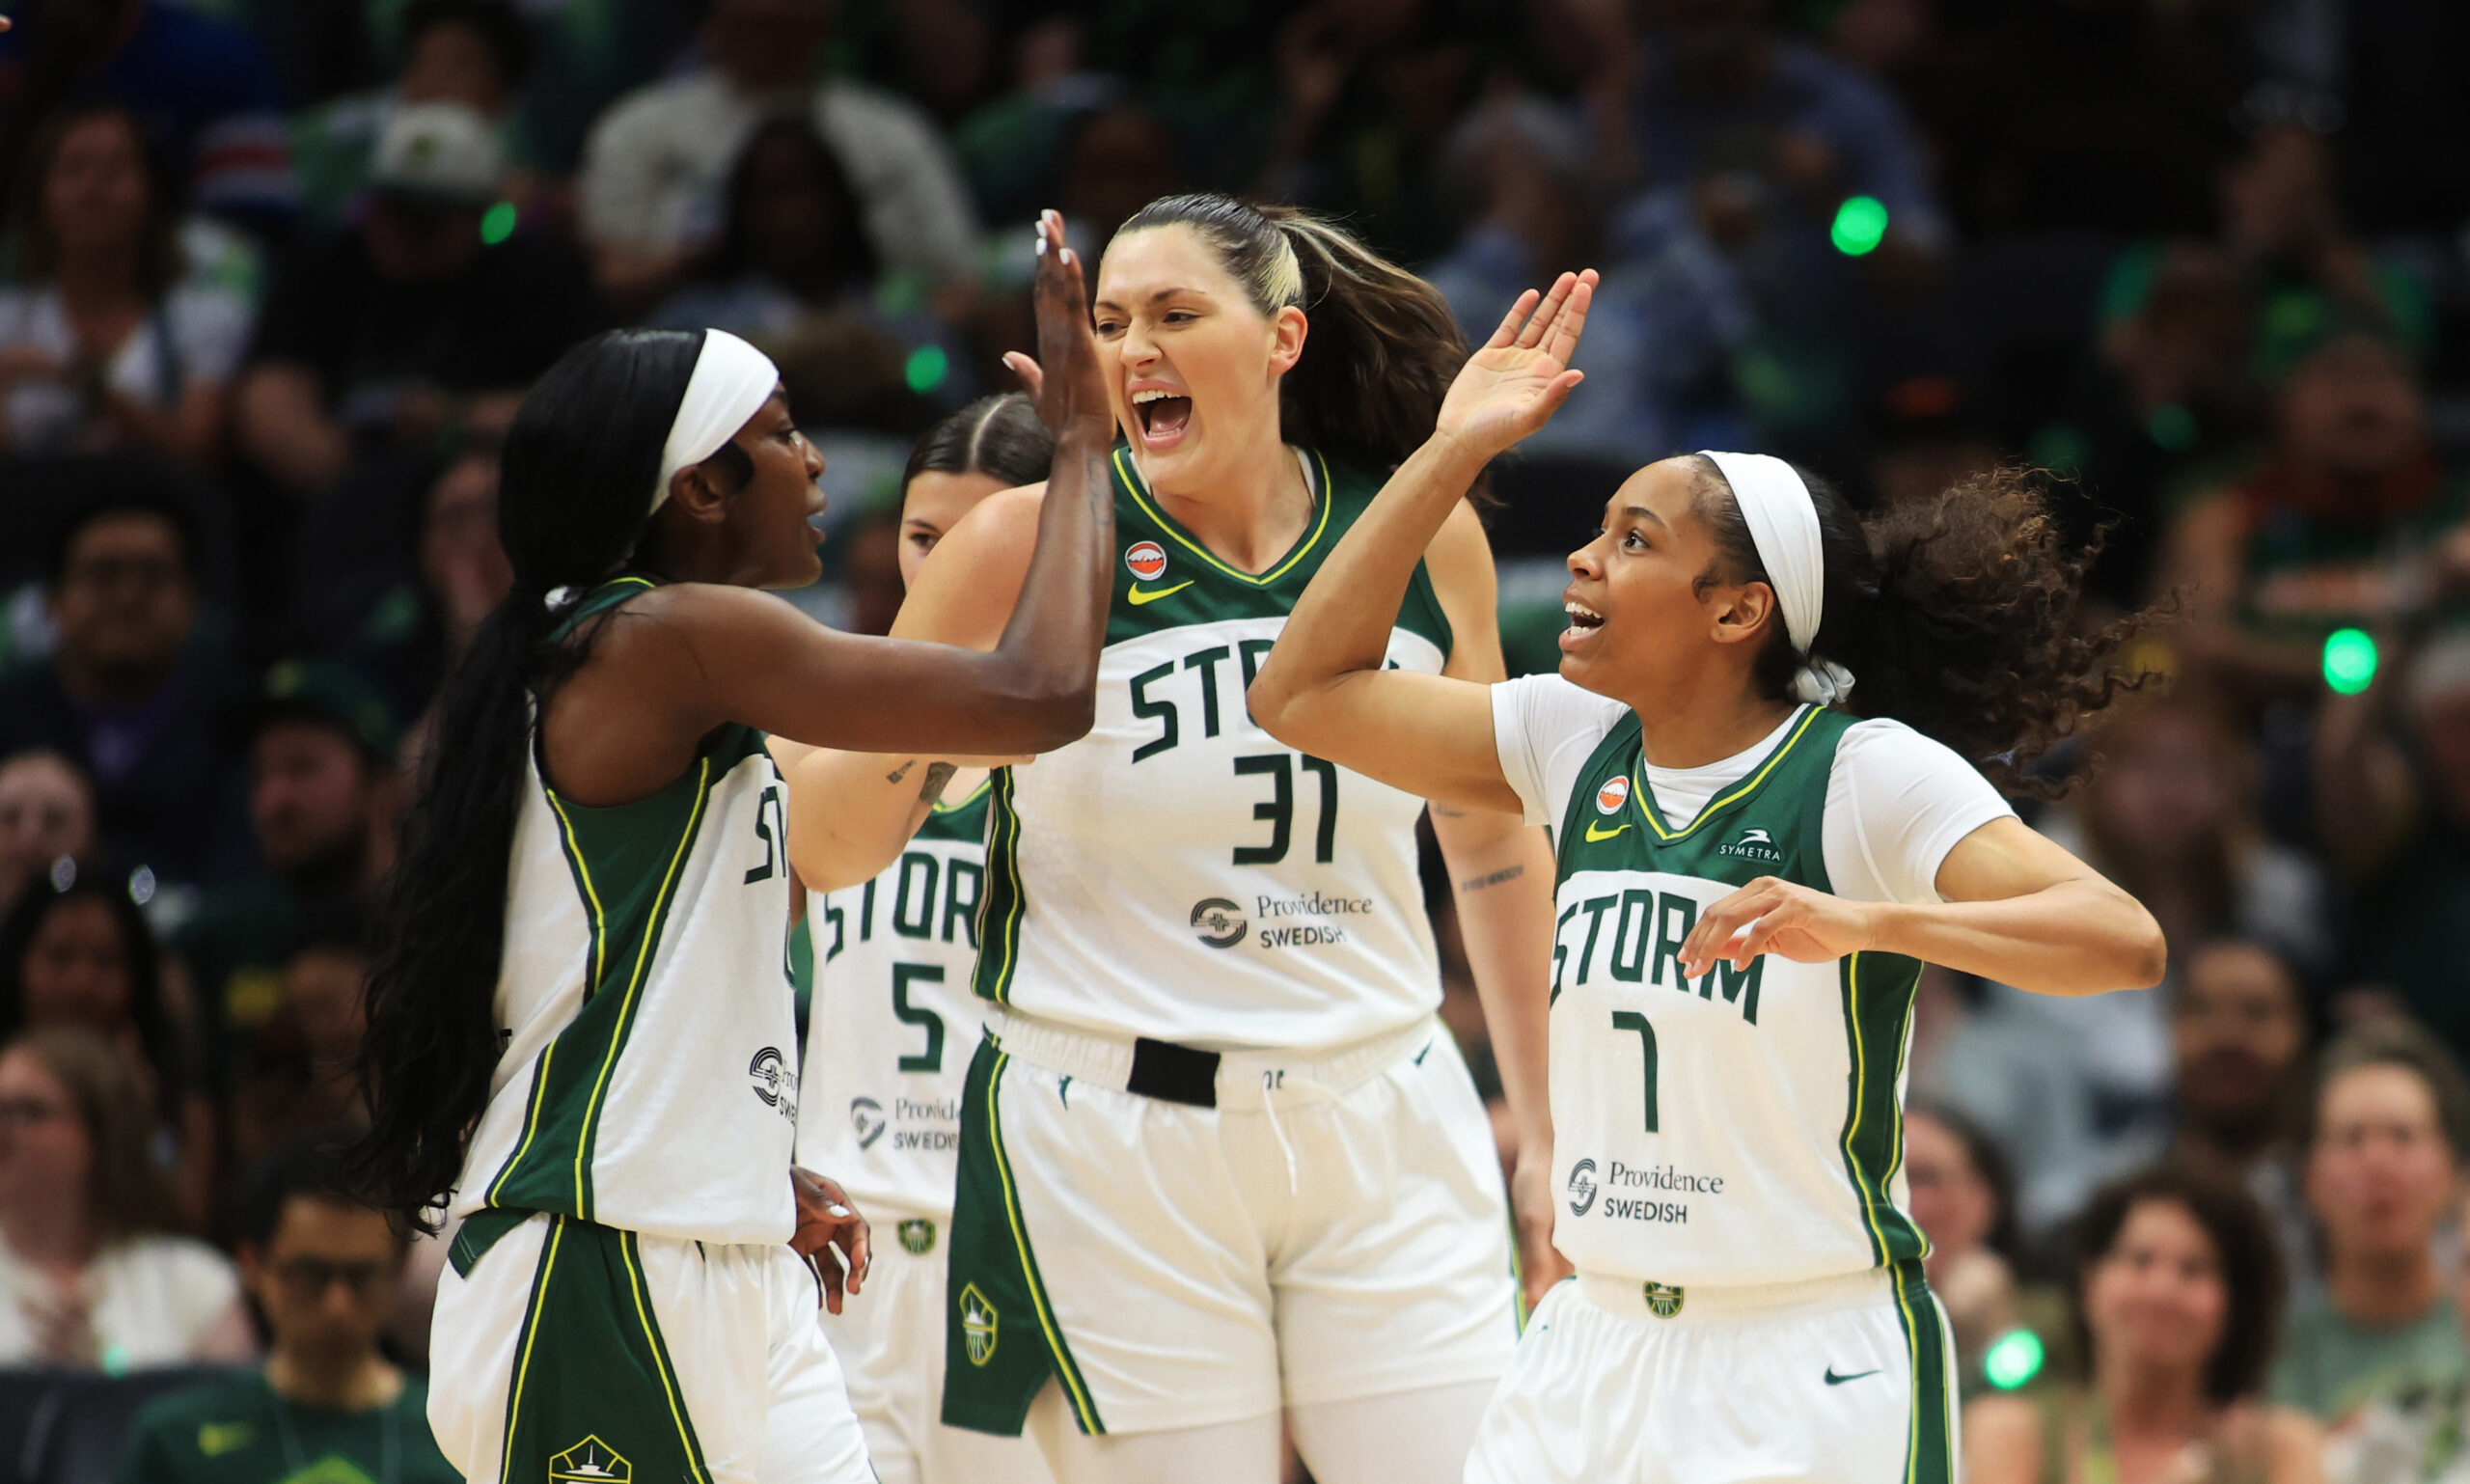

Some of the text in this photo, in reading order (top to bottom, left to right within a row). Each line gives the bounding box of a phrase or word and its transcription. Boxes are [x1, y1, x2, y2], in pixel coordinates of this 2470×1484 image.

[1232, 753, 1339, 866] 31
[1718, 843, 1781, 862] SYMETRA
[1256, 891, 1373, 919] Providence
[1260, 925, 1347, 949] SWEDISH
[1550, 888, 1767, 1027] STORM
[892, 960, 947, 1074] 5
[1610, 1009, 1660, 1134] 7
[1608, 1160, 1724, 1195] Providence
[1603, 1196, 1688, 1224] SWEDISH
